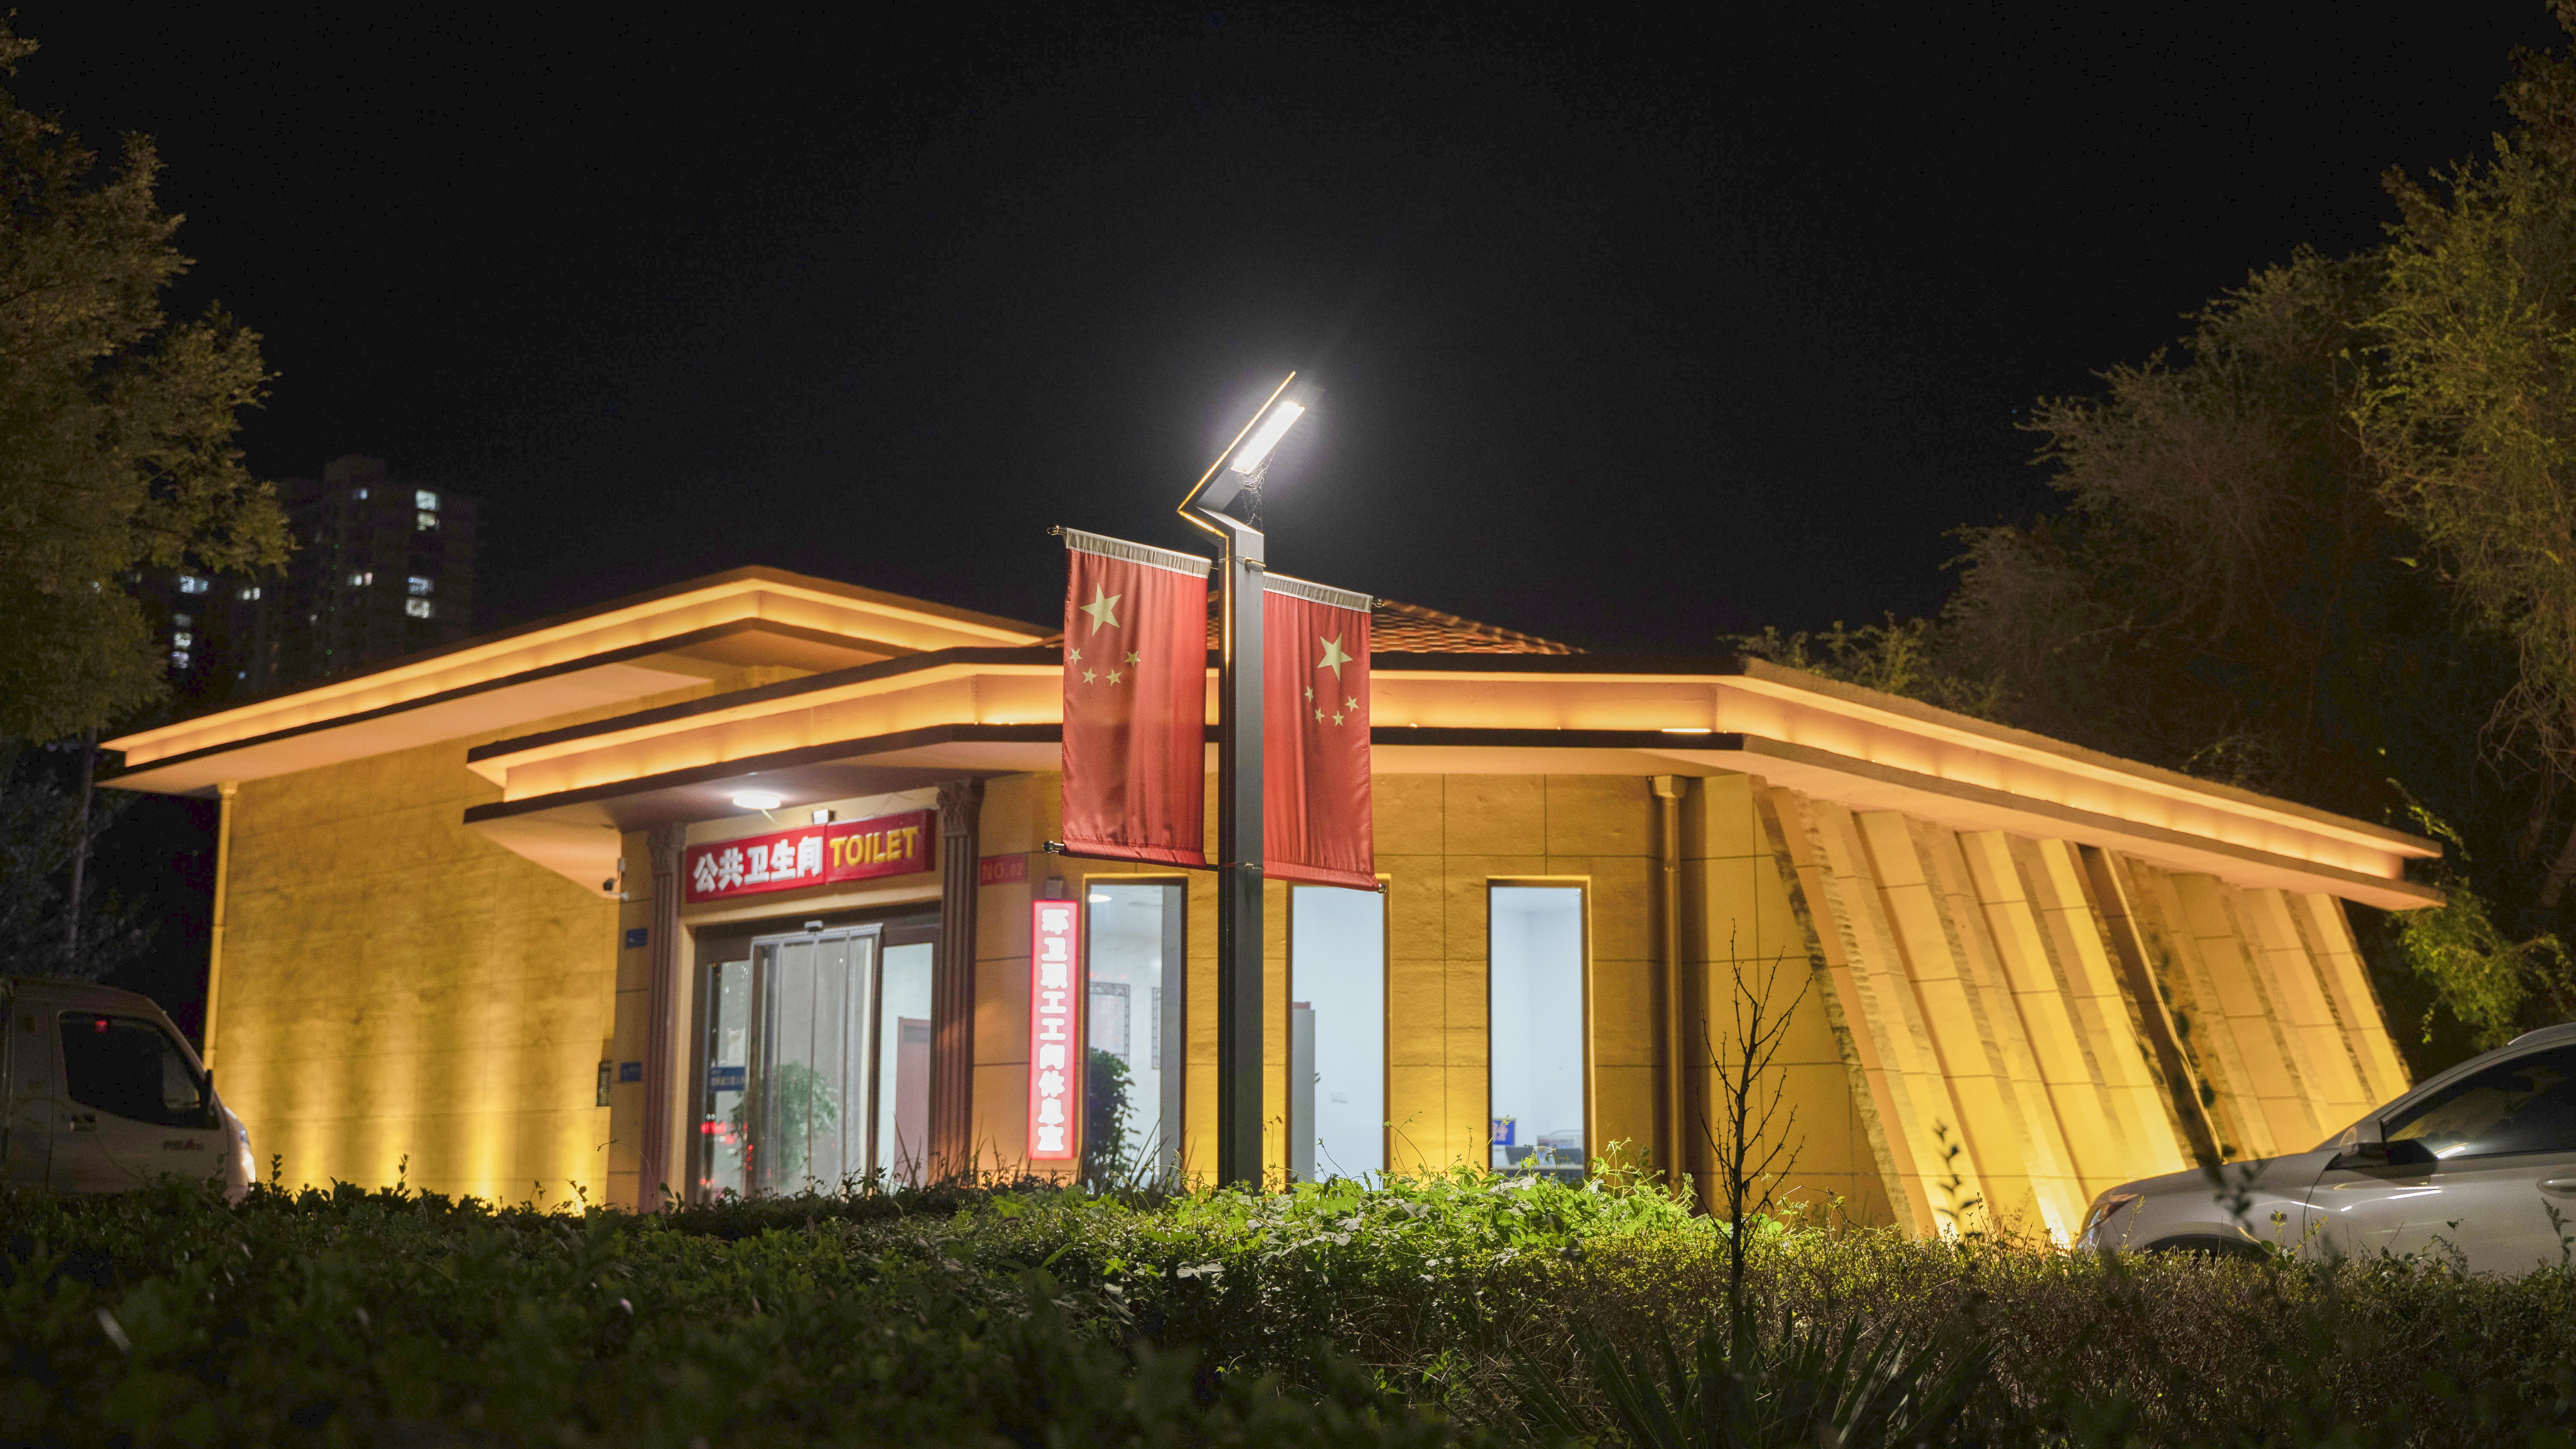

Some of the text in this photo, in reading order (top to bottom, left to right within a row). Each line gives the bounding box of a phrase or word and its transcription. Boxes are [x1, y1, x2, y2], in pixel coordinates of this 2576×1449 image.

[693, 835, 823, 893] 公共卫生间
[829, 826, 919, 869] TOILET
